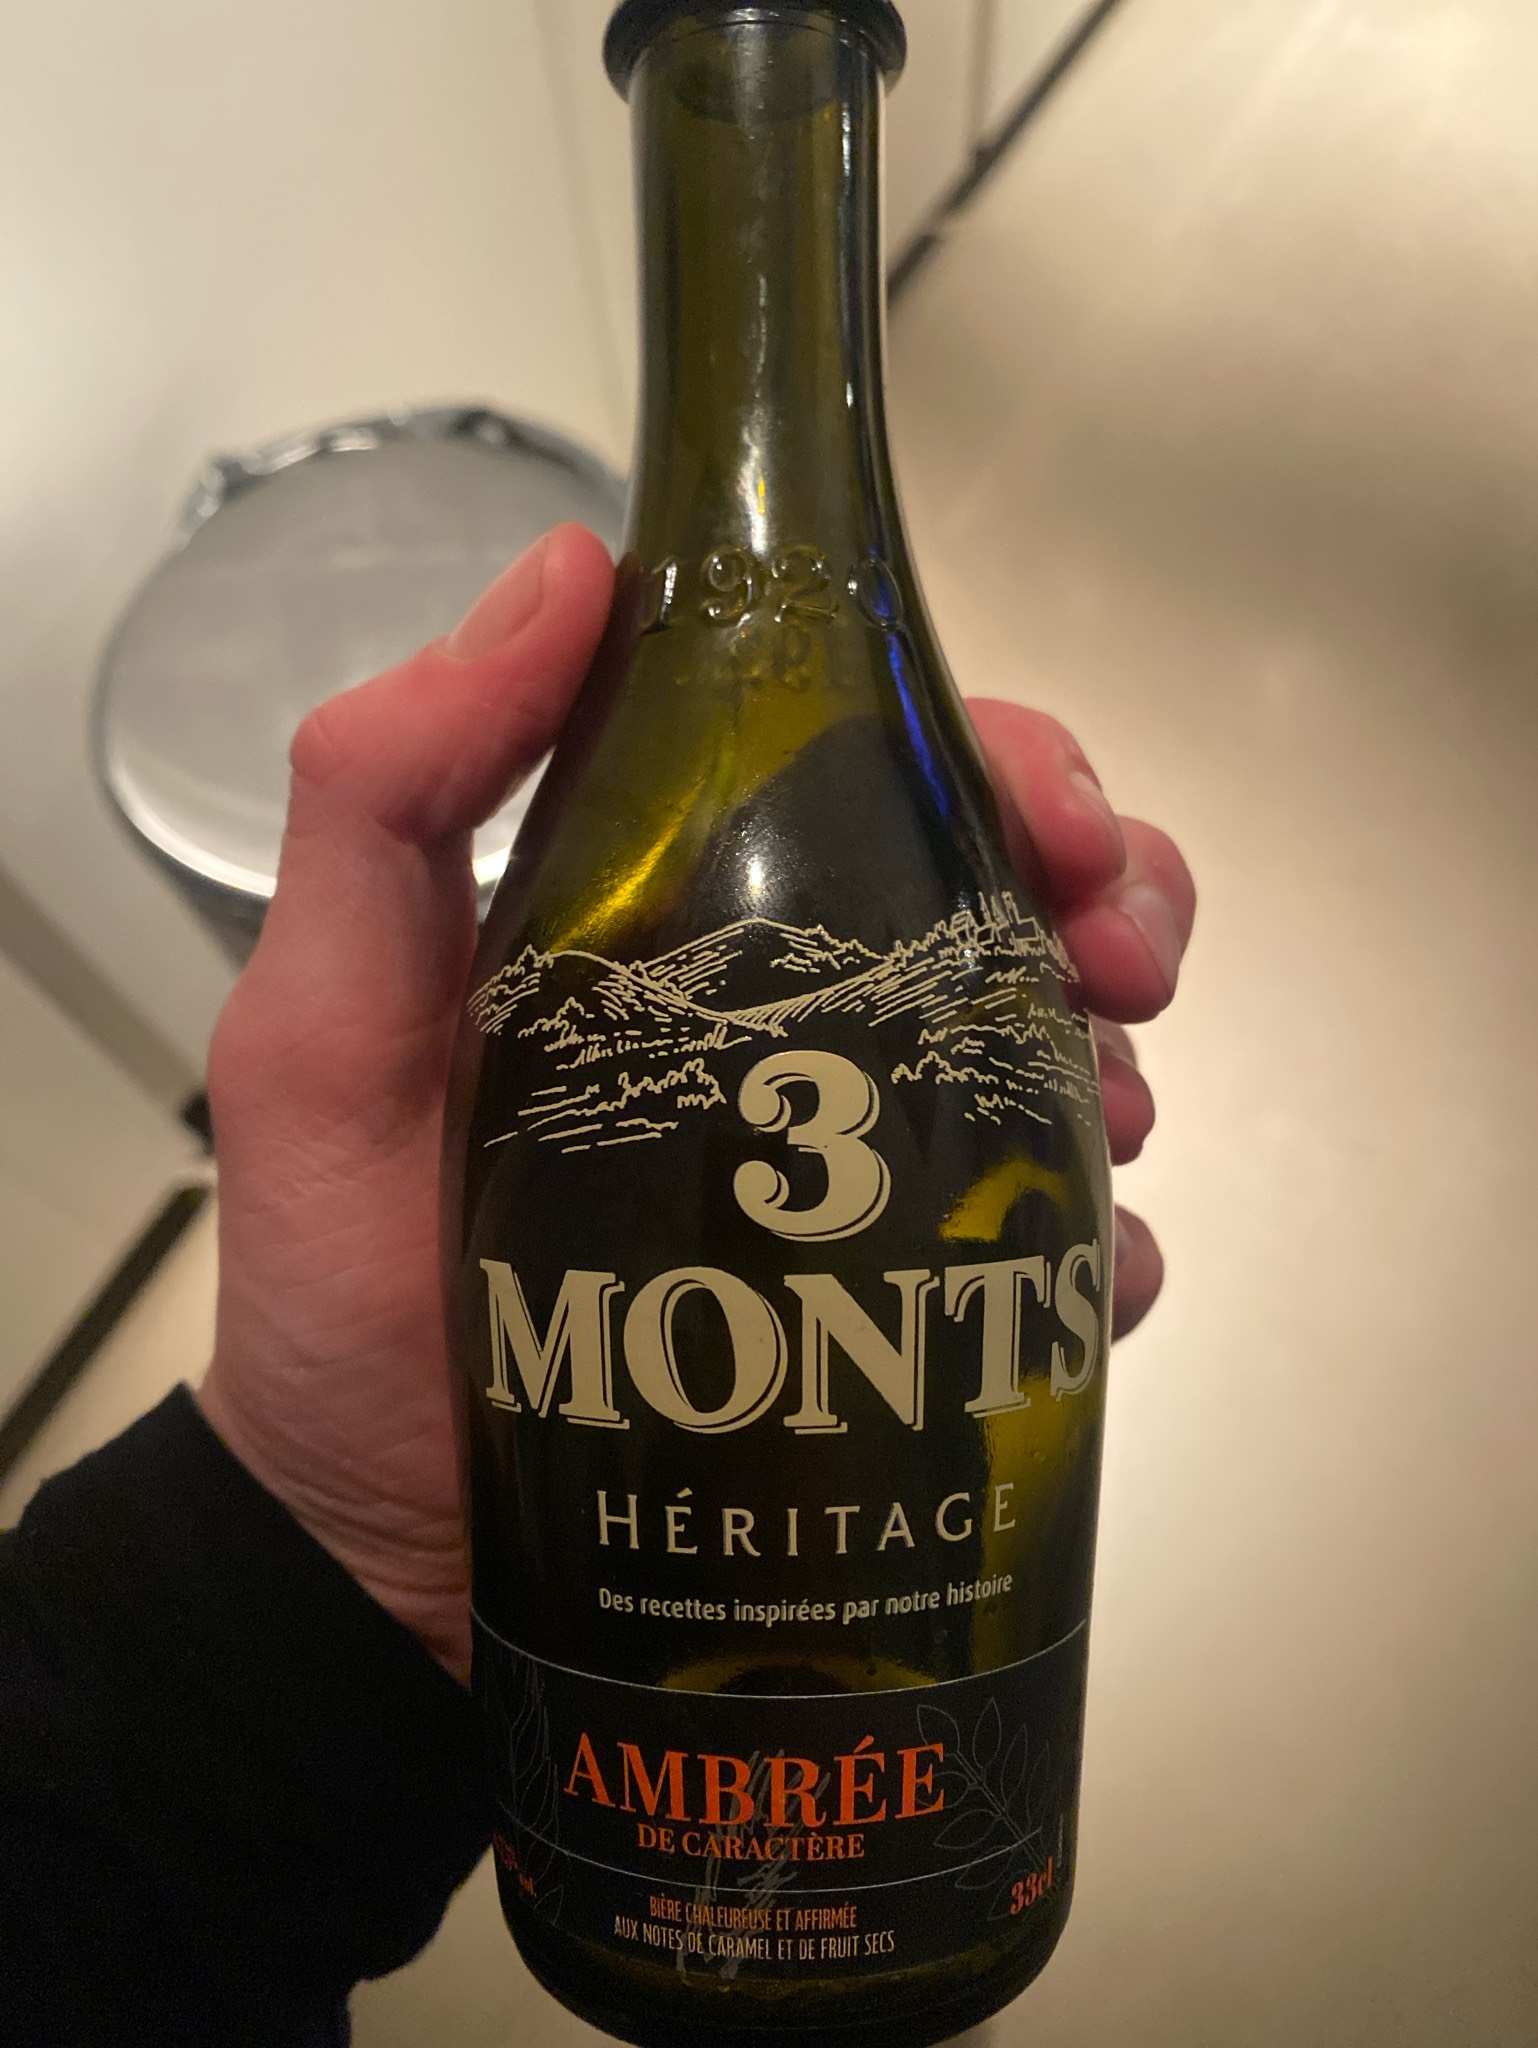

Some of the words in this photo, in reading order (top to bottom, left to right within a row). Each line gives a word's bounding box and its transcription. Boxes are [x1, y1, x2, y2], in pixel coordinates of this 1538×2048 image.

[641, 545, 902, 634] 1920
[733, 1050, 892, 1242] 3
[480, 1239, 1100, 1435] MONTS
[596, 1482, 1017, 1557] HÉRITAGE
[599, 1587, 634, 1613] Des
[640, 1597, 727, 1621] recettes
[733, 1598, 836, 1628] inspirées
[842, 1598, 880, 1625] par
[884, 1590, 941, 1616] notre
[946, 1573, 1014, 1607] histoire
[563, 1732, 946, 1829] AMBRÉE
[637, 1823, 675, 1854] DE
[681, 1830, 866, 1862] CARACTÈRE
[650, 1892, 682, 1922] BIÈRE
[685, 1902, 772, 1932] CHALEUREUSE
[776, 1906, 791, 1931] ET
[795, 1901, 858, 1931] AFFIRMÉE
[1010, 1854, 1054, 1916] 33cl
[614, 1915, 639, 1942] AUX
[642, 1924, 684, 1951] NOTES
[687, 1931, 704, 1955] DE
[708, 1934, 773, 1961] CARAMEL
[778, 1938, 794, 1960] ET
[798, 1937, 816, 1960] DE
[820, 1935, 861, 1959] FRUIT
[864, 1929, 896, 1956] SECS
